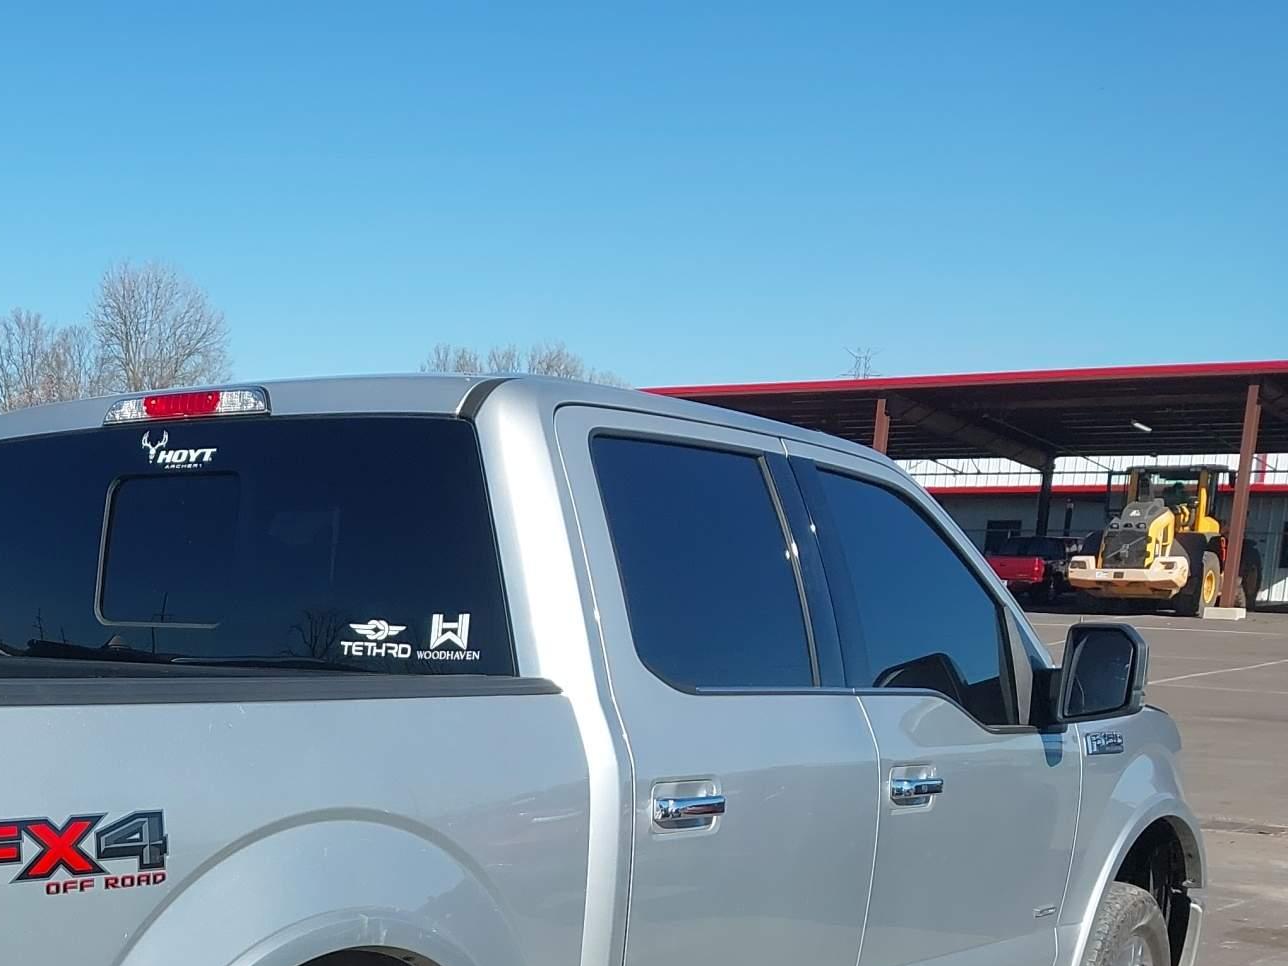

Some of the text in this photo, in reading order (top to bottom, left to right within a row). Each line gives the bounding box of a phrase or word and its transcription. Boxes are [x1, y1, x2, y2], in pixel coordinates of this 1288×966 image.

[157, 448, 217, 463] HOYT
[340, 641, 412, 658] TETHRD
[416, 650, 481, 661] WOODHAVEN
[45, 871, 167, 896] OFF ROAD
